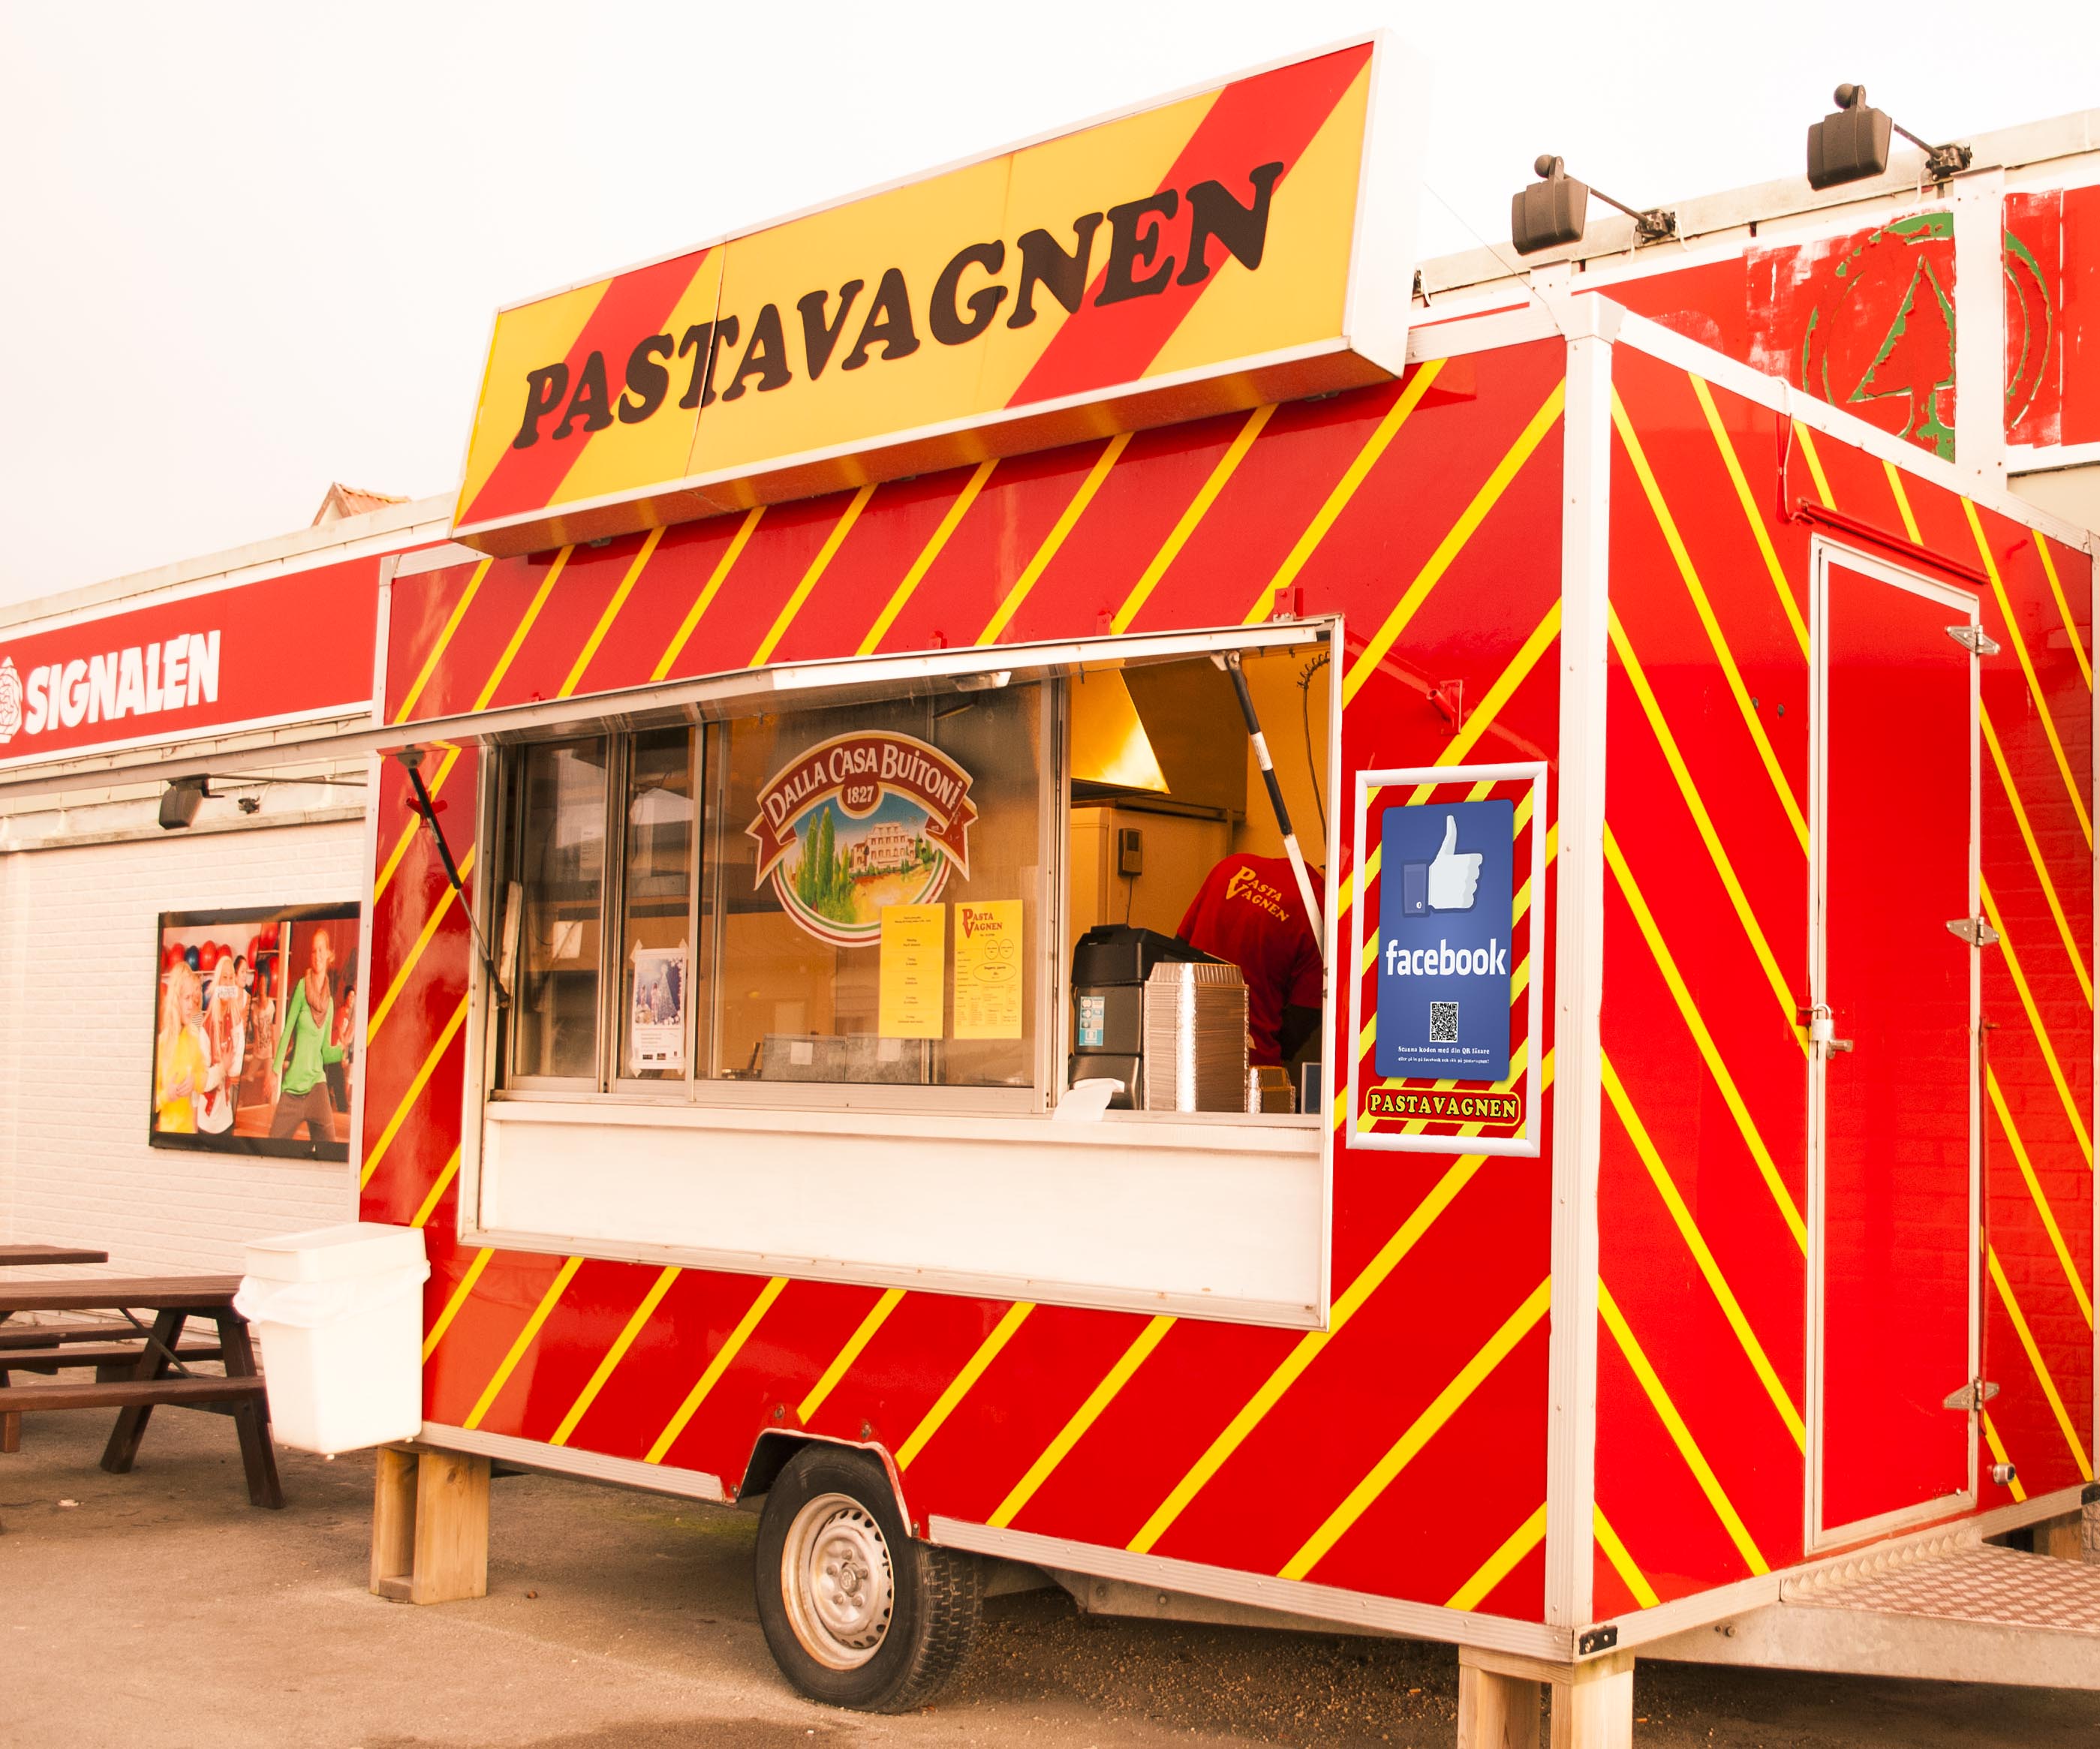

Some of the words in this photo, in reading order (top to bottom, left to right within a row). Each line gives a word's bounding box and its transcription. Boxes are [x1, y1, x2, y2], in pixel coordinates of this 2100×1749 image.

[513, 161, 1285, 449] PASTAVAGNEN
[24, 629, 221, 735] SIGNALEN
[766, 762, 827, 828] DALLA
[829, 747, 878, 783] CASA
[847, 786, 874, 804] 1827
[1226, 878, 1289, 922] VAGNEN
[1232, 865, 1283, 902] PASTA
[962, 909, 994, 921] PASTA
[963, 921, 1003, 939] VAGNEN
[1385, 938, 1507, 976] facebook
[1370, 1093, 1517, 1119] PASTAVAGNEN
